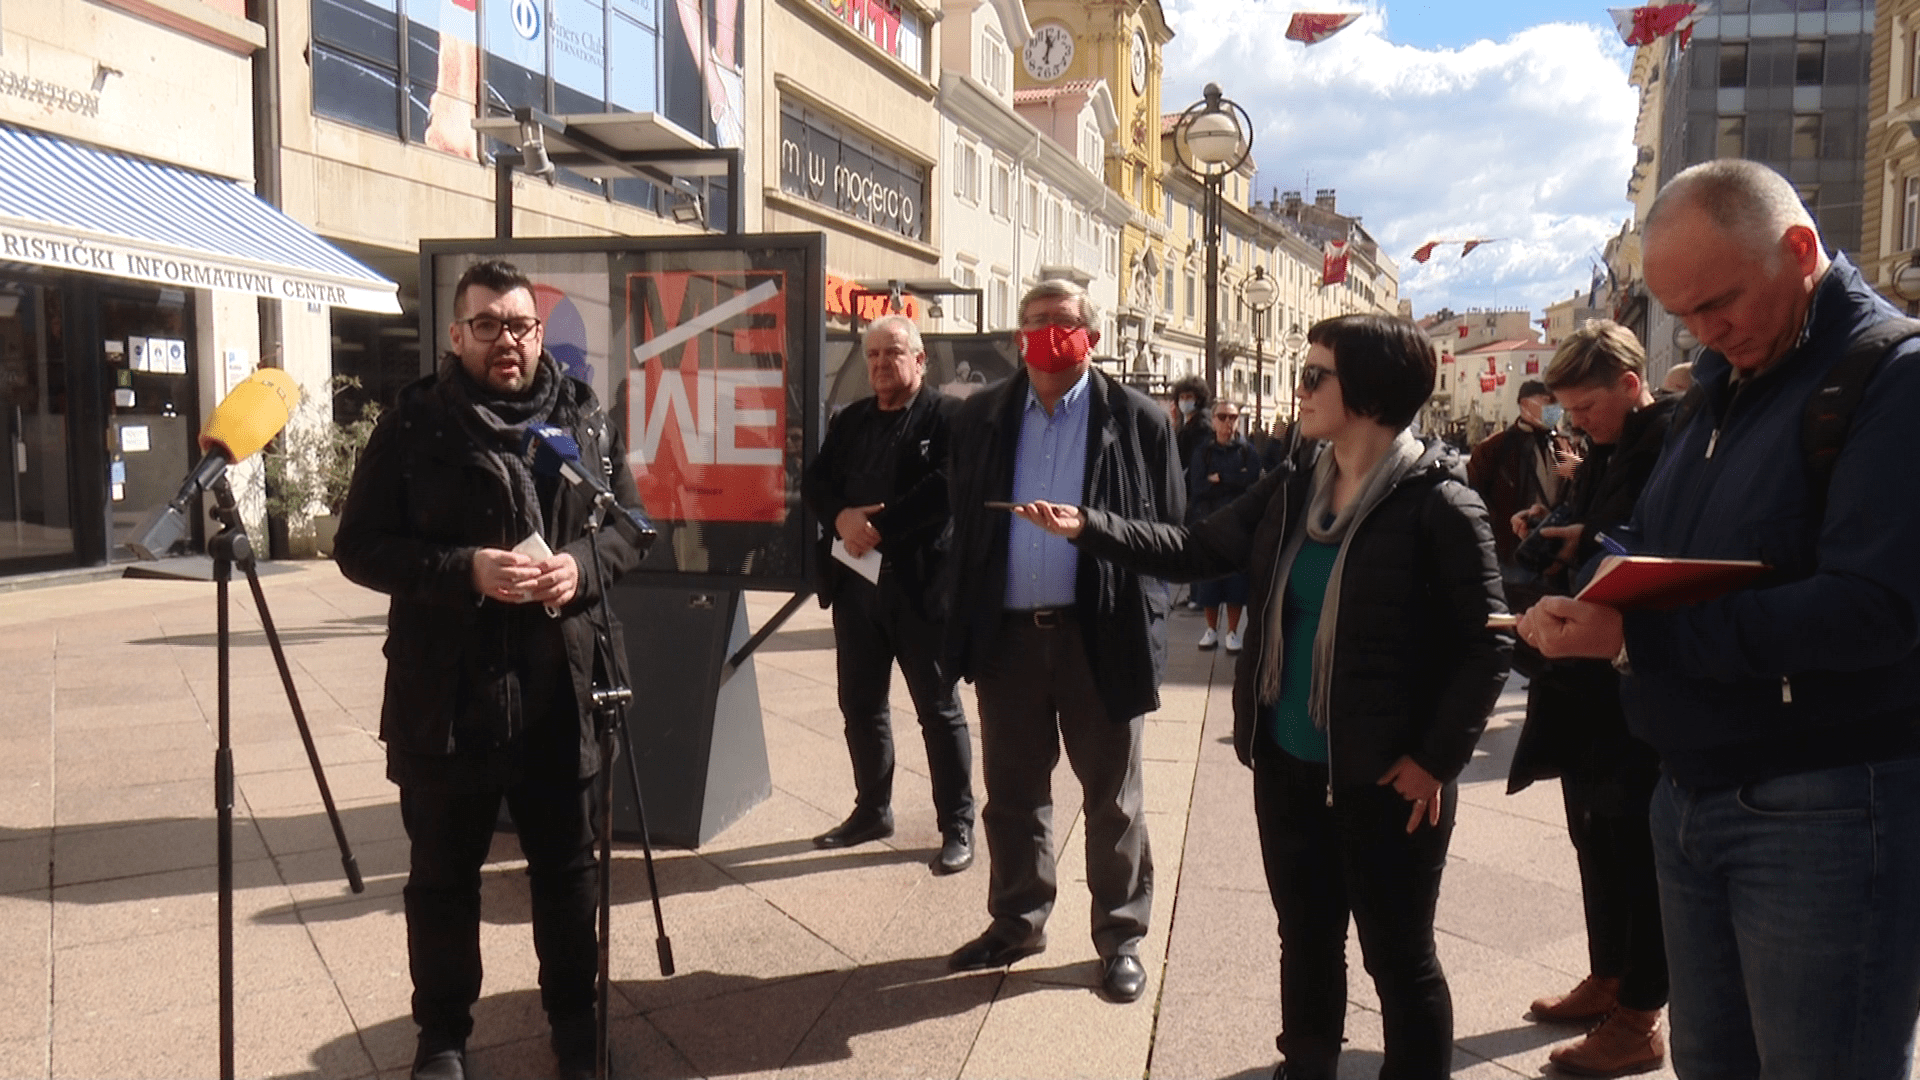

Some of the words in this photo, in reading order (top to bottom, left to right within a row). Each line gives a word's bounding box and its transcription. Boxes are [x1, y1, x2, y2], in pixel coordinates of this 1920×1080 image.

[548, 15, 580, 43] iners
[2, 232, 115, 271] RISTIČKI
[127, 253, 274, 294] INFORMATIVNI
[282, 279, 348, 305] CENTAR
[628, 369, 784, 465] WE
